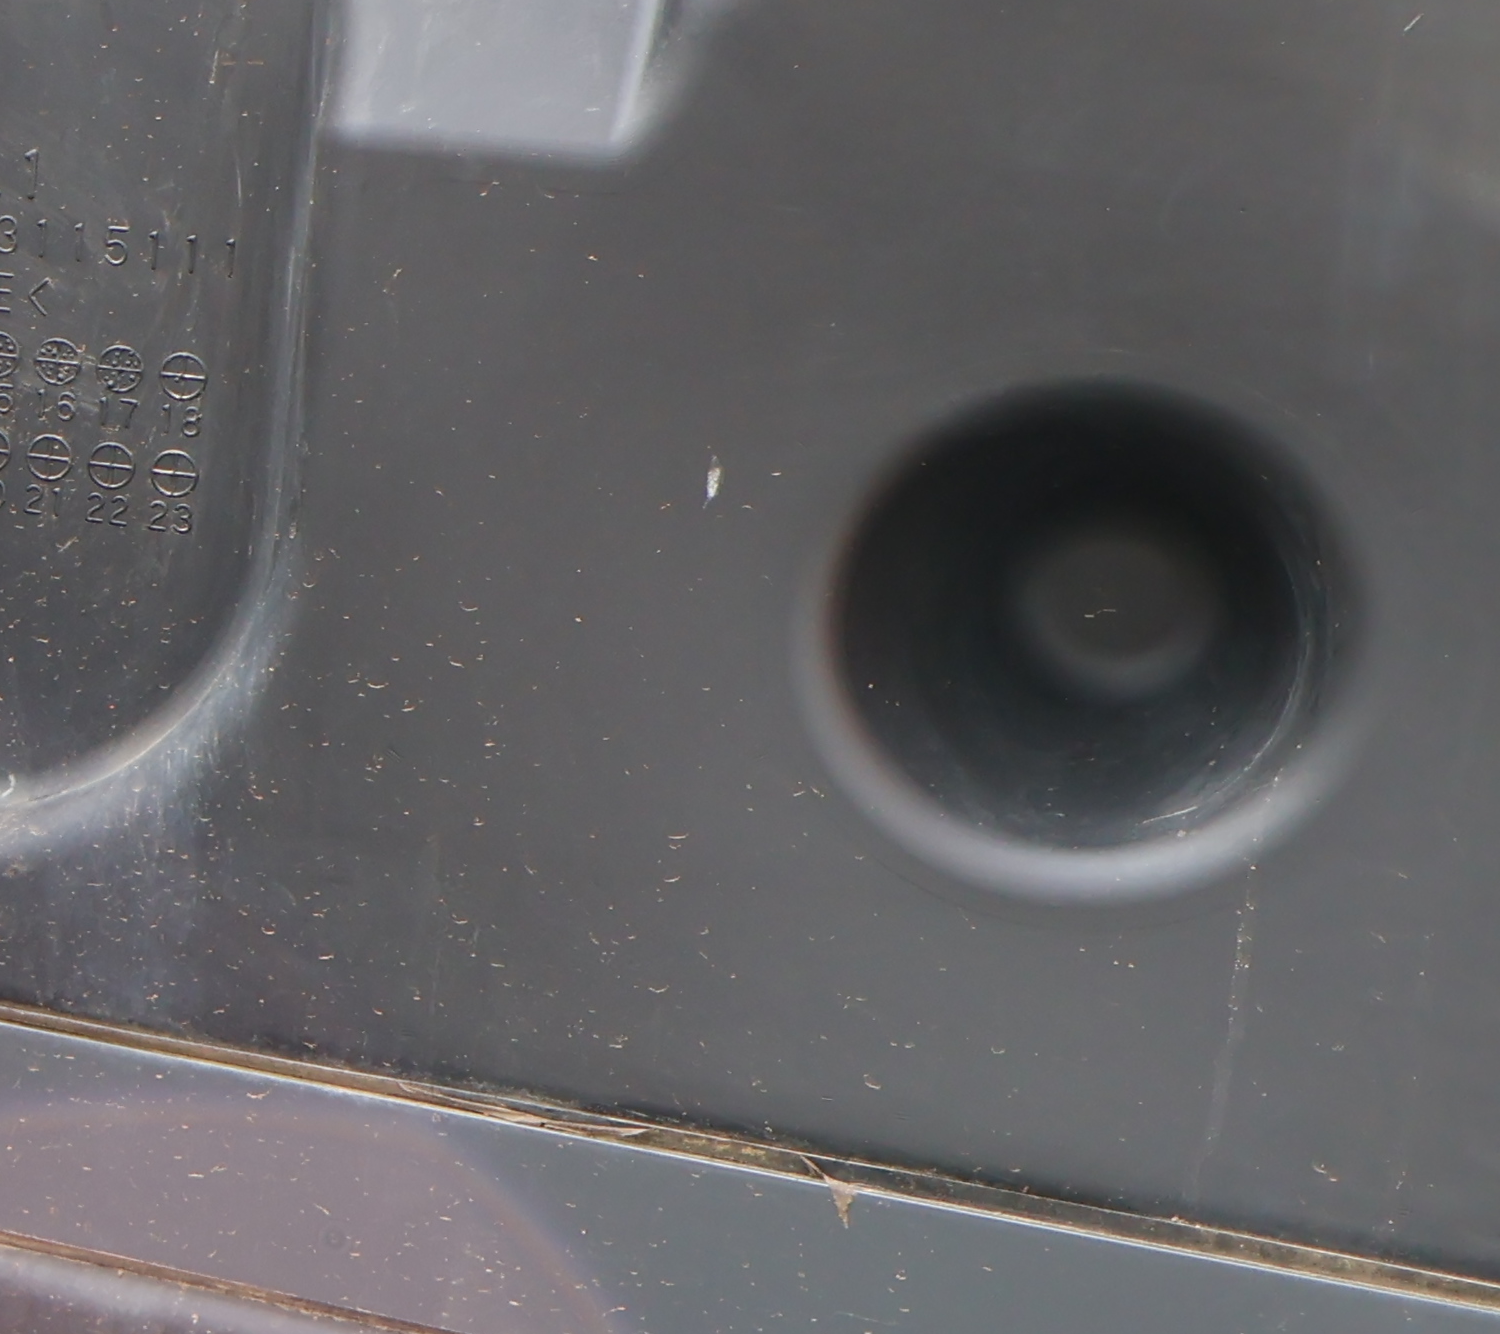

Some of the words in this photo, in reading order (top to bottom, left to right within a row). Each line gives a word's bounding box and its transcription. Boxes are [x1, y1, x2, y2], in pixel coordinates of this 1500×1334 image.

[36, 387, 76, 423] 16
[98, 395, 139, 431] 17
[162, 403, 203, 438] 18
[24, 483, 62, 518] 21
[86, 492, 129, 527] 22
[149, 499, 194, 535] 23
